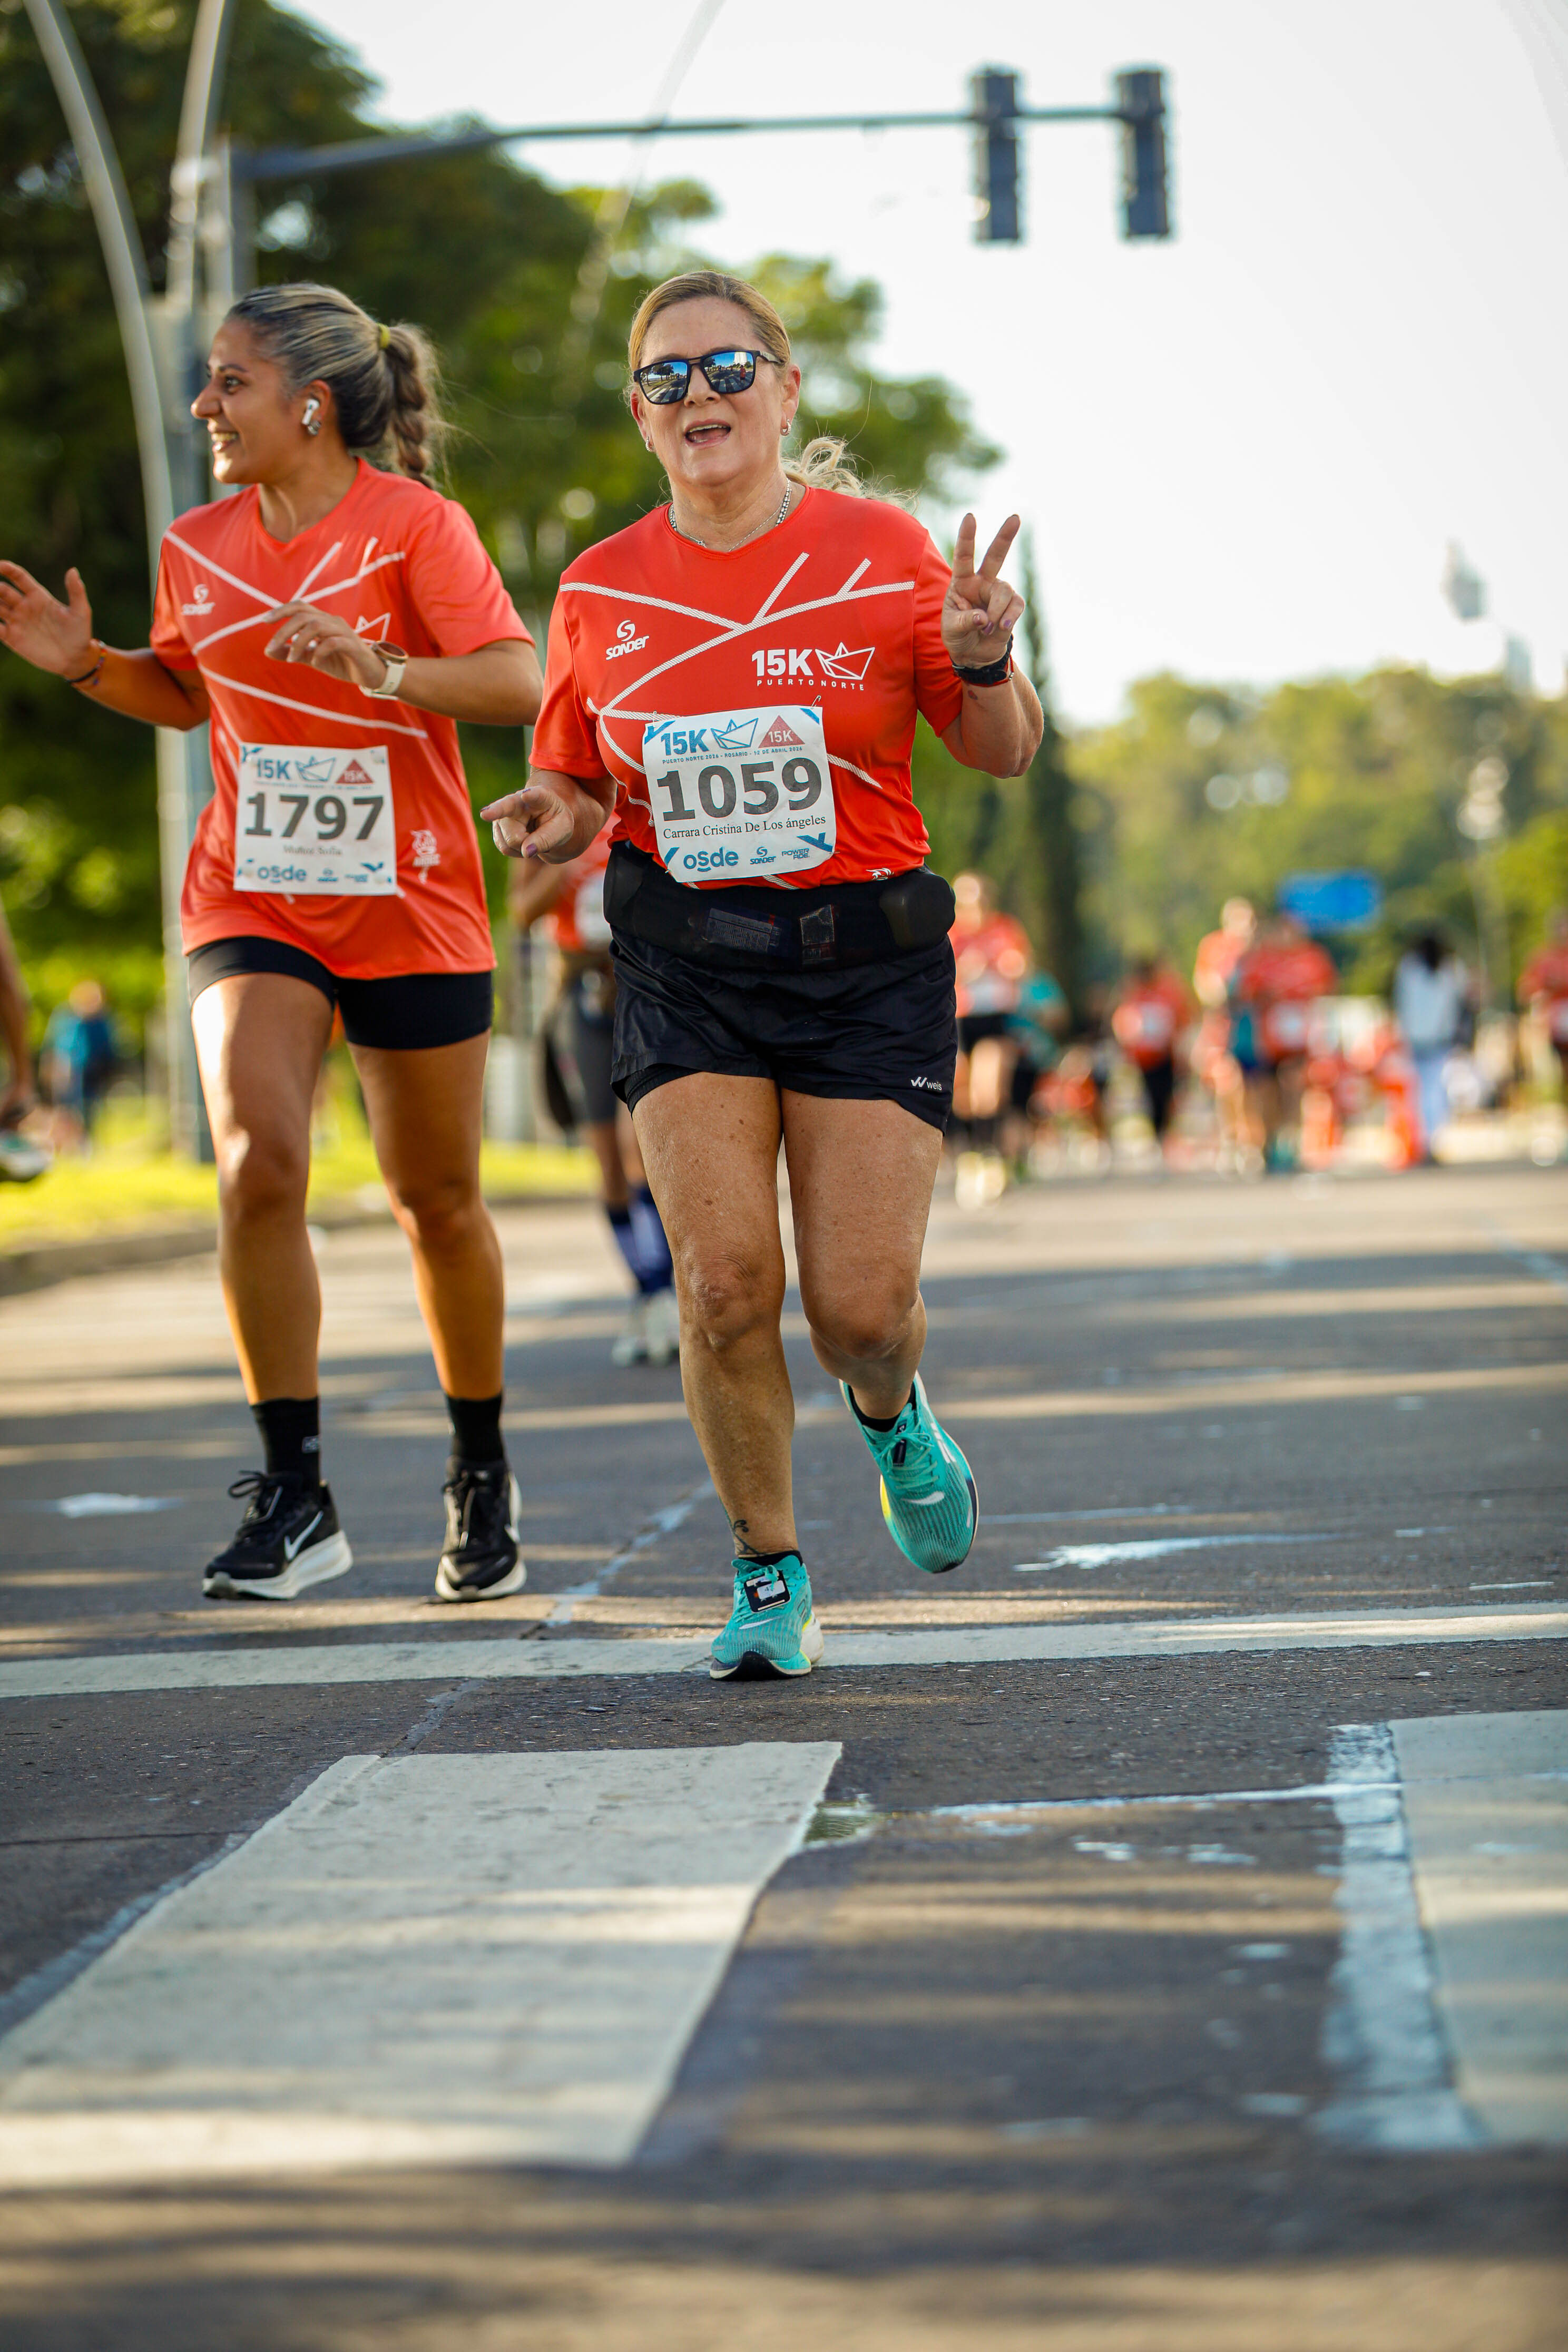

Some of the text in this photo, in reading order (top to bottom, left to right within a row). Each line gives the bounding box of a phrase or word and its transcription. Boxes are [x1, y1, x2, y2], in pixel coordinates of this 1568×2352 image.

[751, 649, 814, 677] 15K
[821, 680, 865, 691] NORTE
[660, 729, 710, 756] 15K
[768, 730, 793, 743] 15K
[257, 759, 290, 780] 15K
[656, 758, 822, 821] 1059
[245, 792, 384, 840] 1797
[663, 815, 826, 839] Carrara Cristina De Los ángeles
[683, 846, 739, 870] osde
[781, 848, 809, 856] POWER
[257, 865, 307, 882] osde
[927, 1081, 942, 1091] weis
